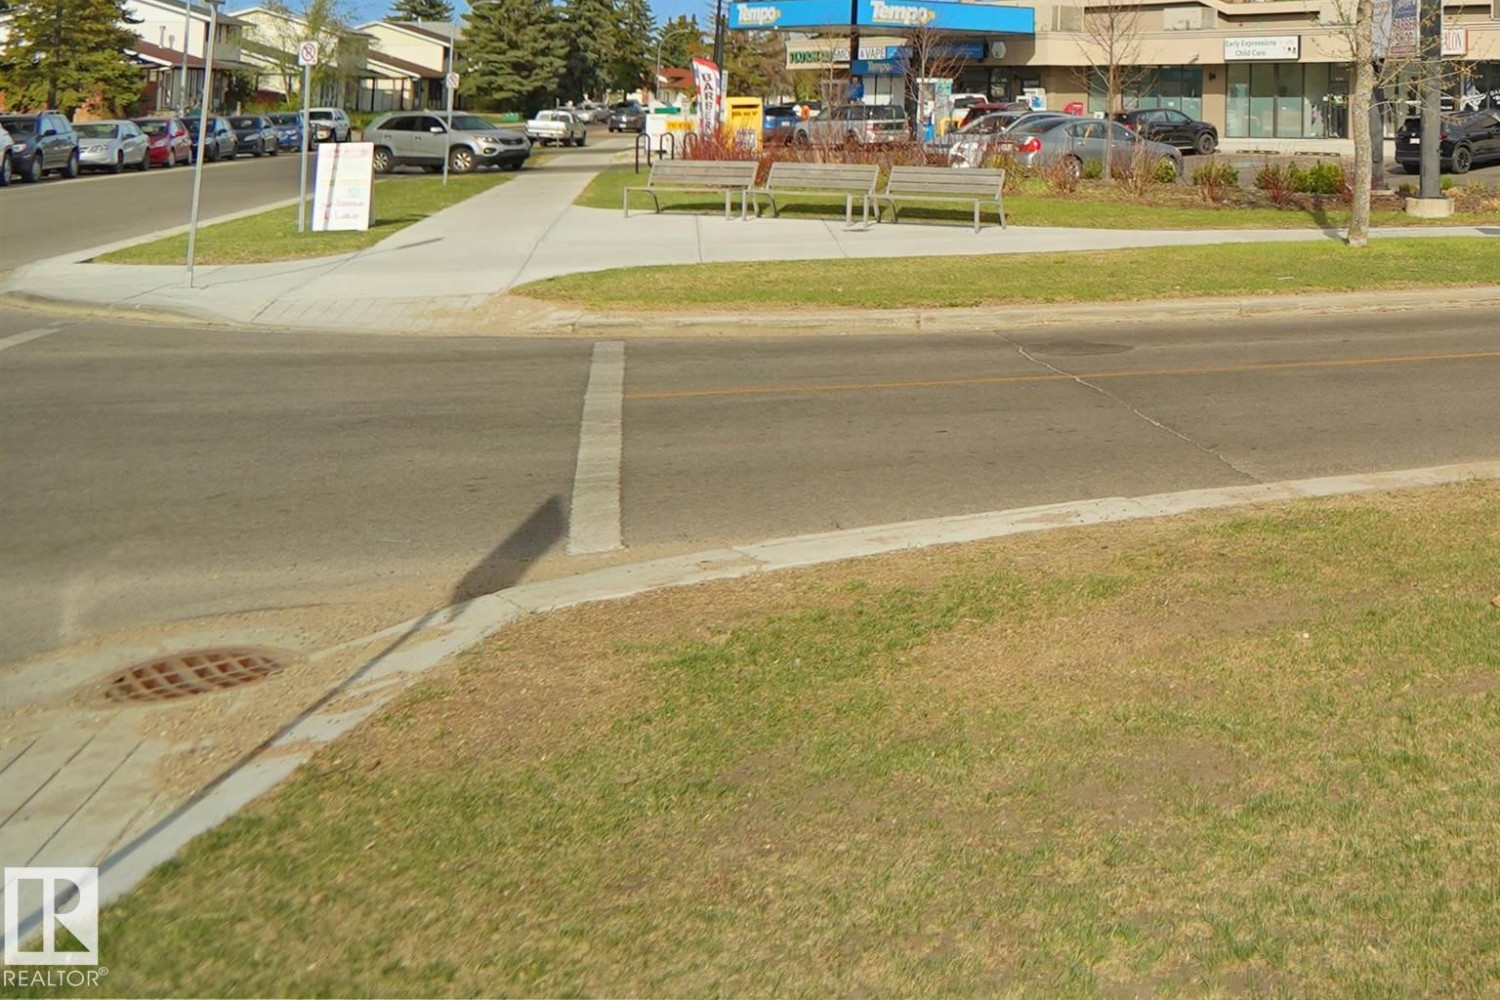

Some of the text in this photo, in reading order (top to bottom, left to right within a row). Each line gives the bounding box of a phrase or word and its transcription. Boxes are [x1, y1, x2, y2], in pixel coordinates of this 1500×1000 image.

[737, 4, 777, 25] Tempo
[870, 0, 929, 24] Tempo
[1225, 40, 1277, 48] Early Expressions
[1442, 29, 1462, 51] ALON
[866, 48, 886, 59] VAPE
[702, 73, 714, 131] BARBER
